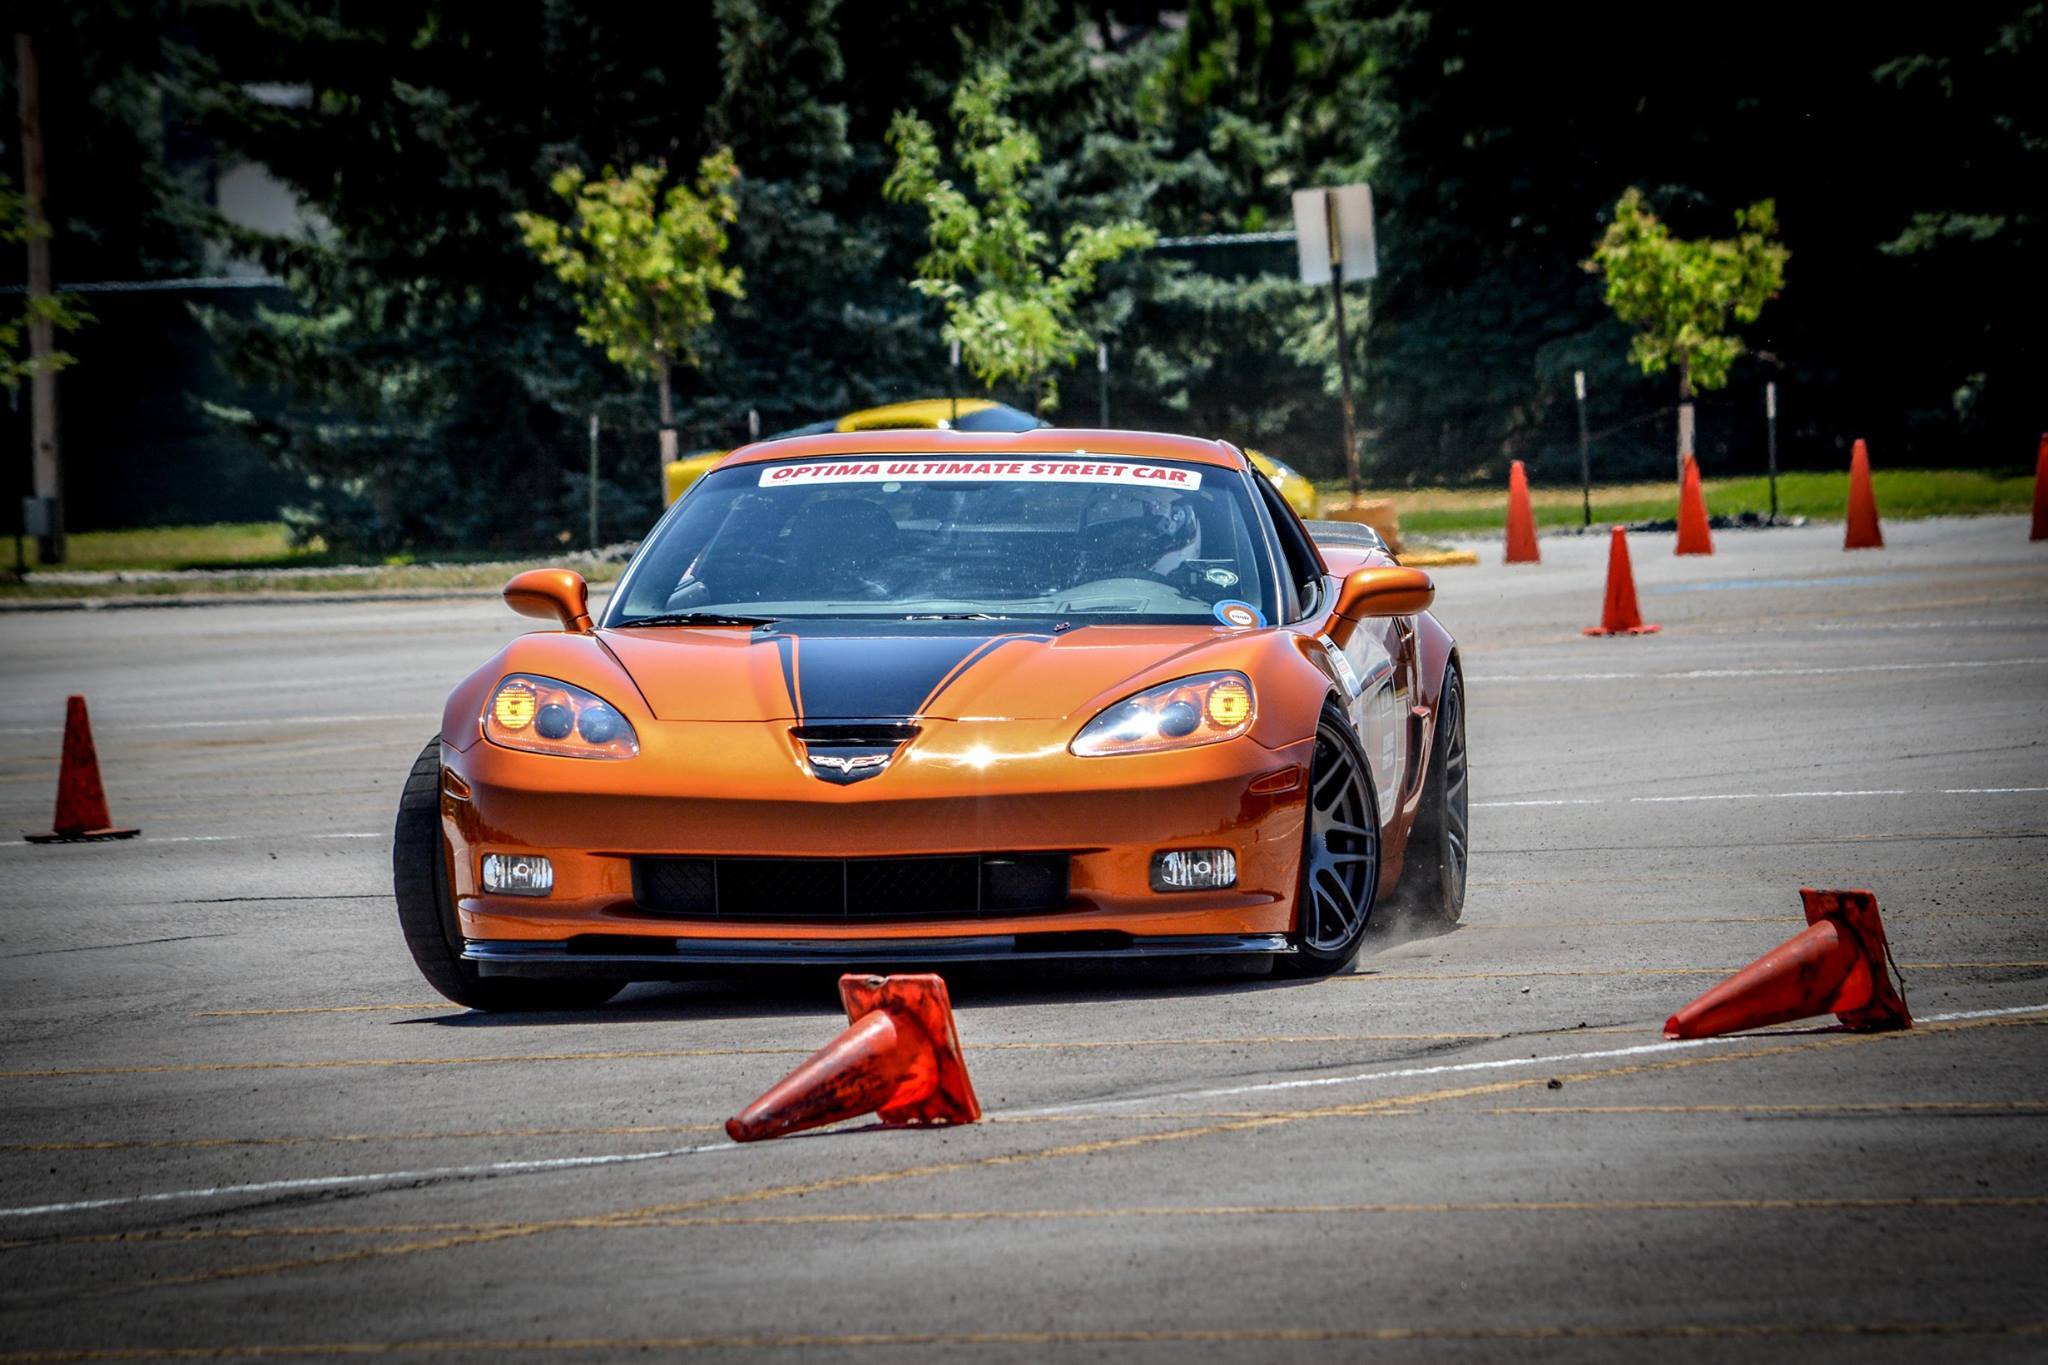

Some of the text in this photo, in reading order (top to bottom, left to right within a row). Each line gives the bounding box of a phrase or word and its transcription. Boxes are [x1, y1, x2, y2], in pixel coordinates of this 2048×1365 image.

[772, 463, 1188, 482] OPTIMA ULTIMATE STREET CAR
